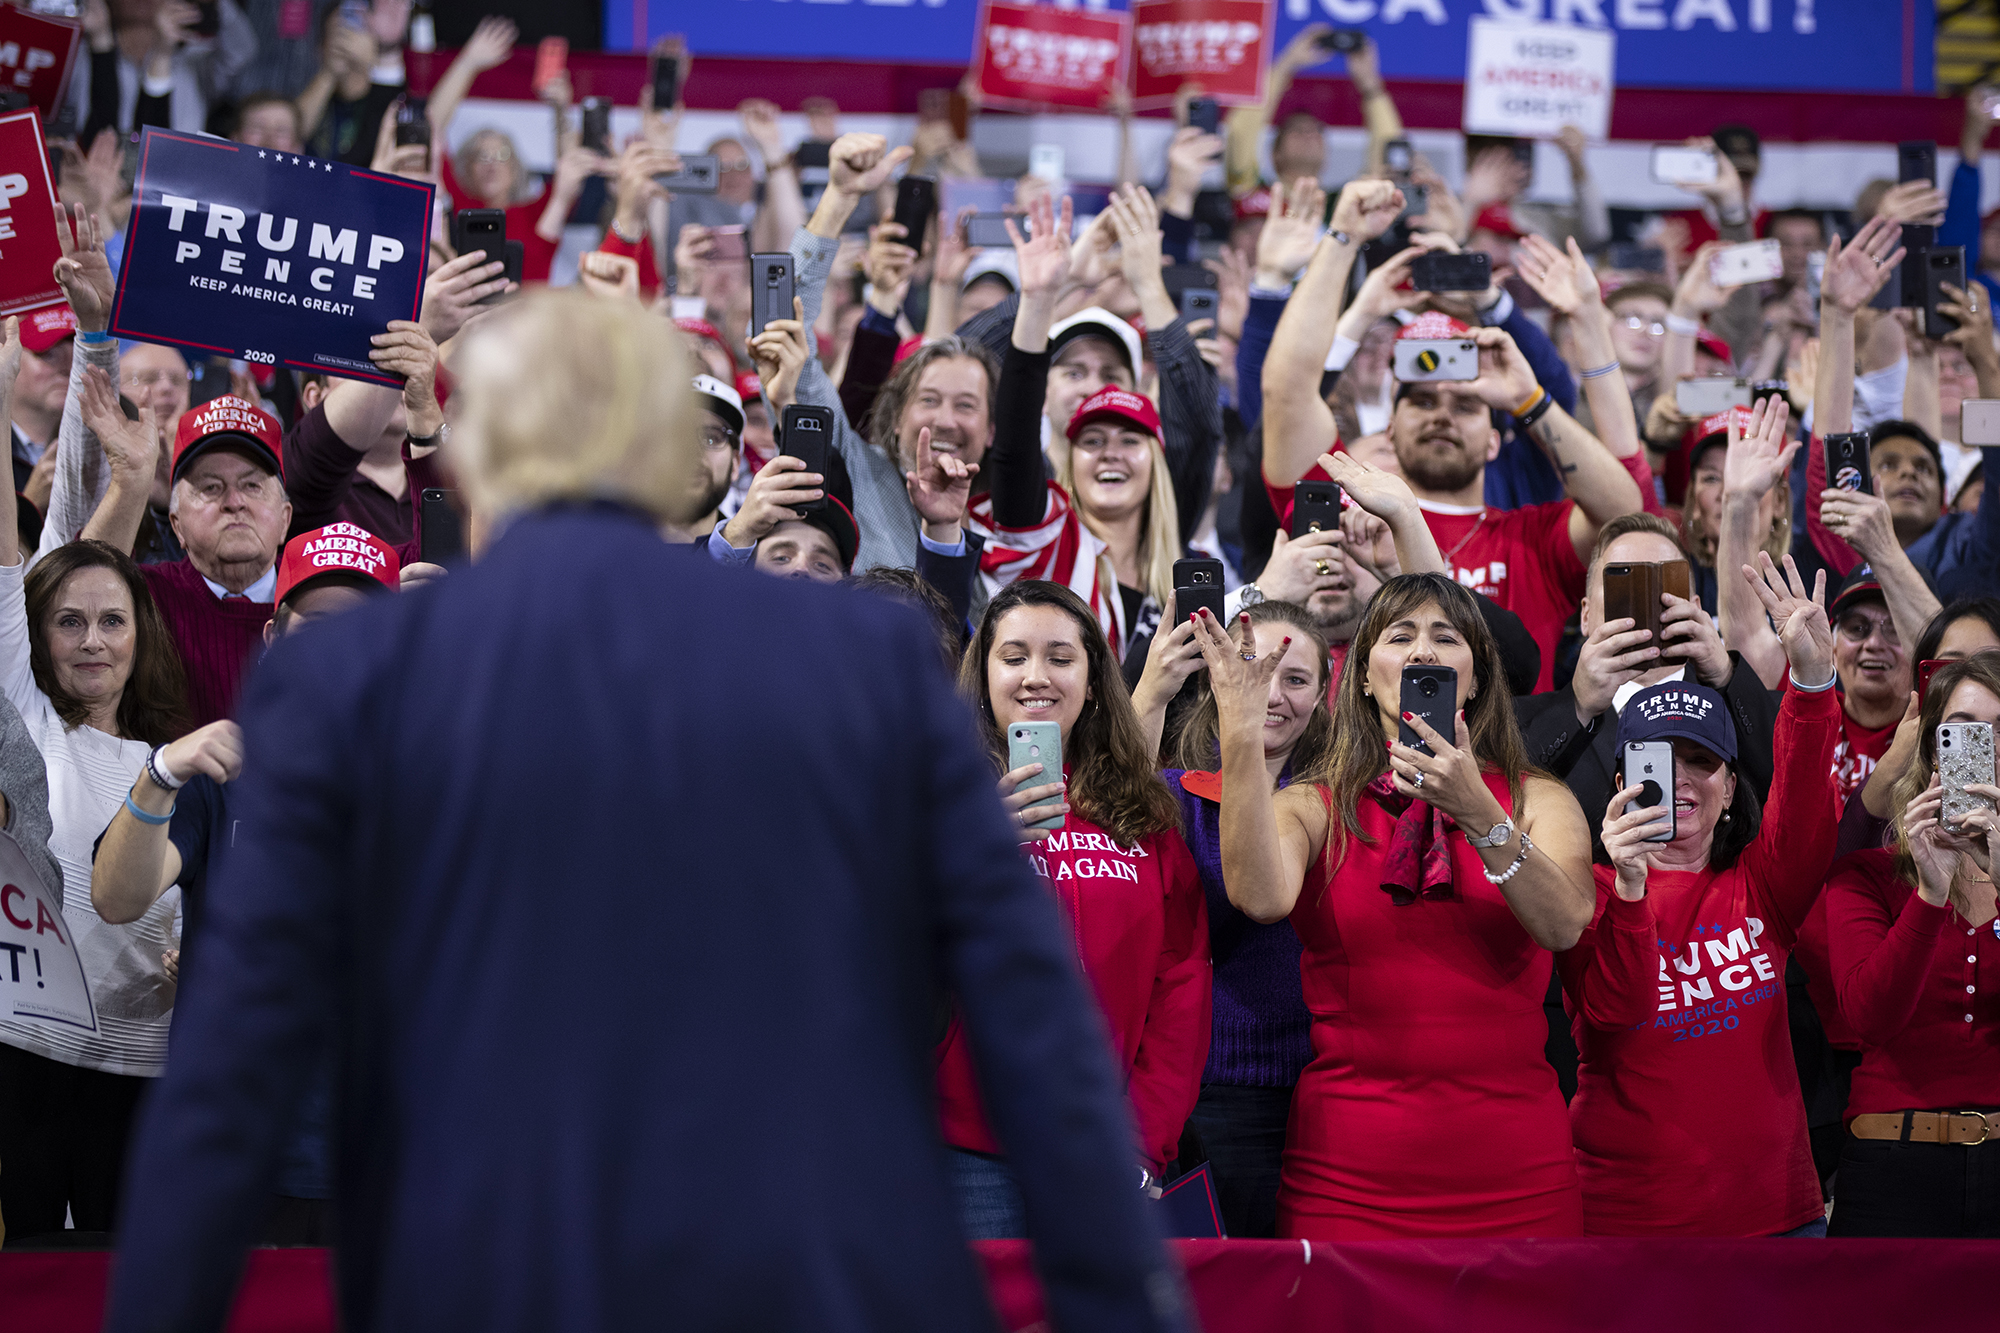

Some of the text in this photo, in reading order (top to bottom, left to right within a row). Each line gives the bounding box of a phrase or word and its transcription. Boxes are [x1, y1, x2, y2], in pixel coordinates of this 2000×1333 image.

[161, 193, 404, 270] TRUMP
[175, 240, 377, 300] PENCE
[189, 275, 355, 317] KEEP AMERICA GREAT!
[243, 349, 276, 364] 2020
[209, 395, 252, 411] KEEP
[193, 408, 267, 432] AMERICA
[321, 522, 371, 541] KEEP
[302, 537, 386, 567] AMERICA
[312, 551, 377, 574] GREAT
[1637, 692, 1713, 712] TRUMP
[1644, 702, 1706, 718] PENCE
[1056, 857, 1138, 884] AGAIN
[1658, 917, 1764, 982] RUMP
[1657, 953, 1776, 1012] ENCE
[1653, 998, 1738, 1029] AMERICA
[1673, 1015, 1740, 1042] 2020
